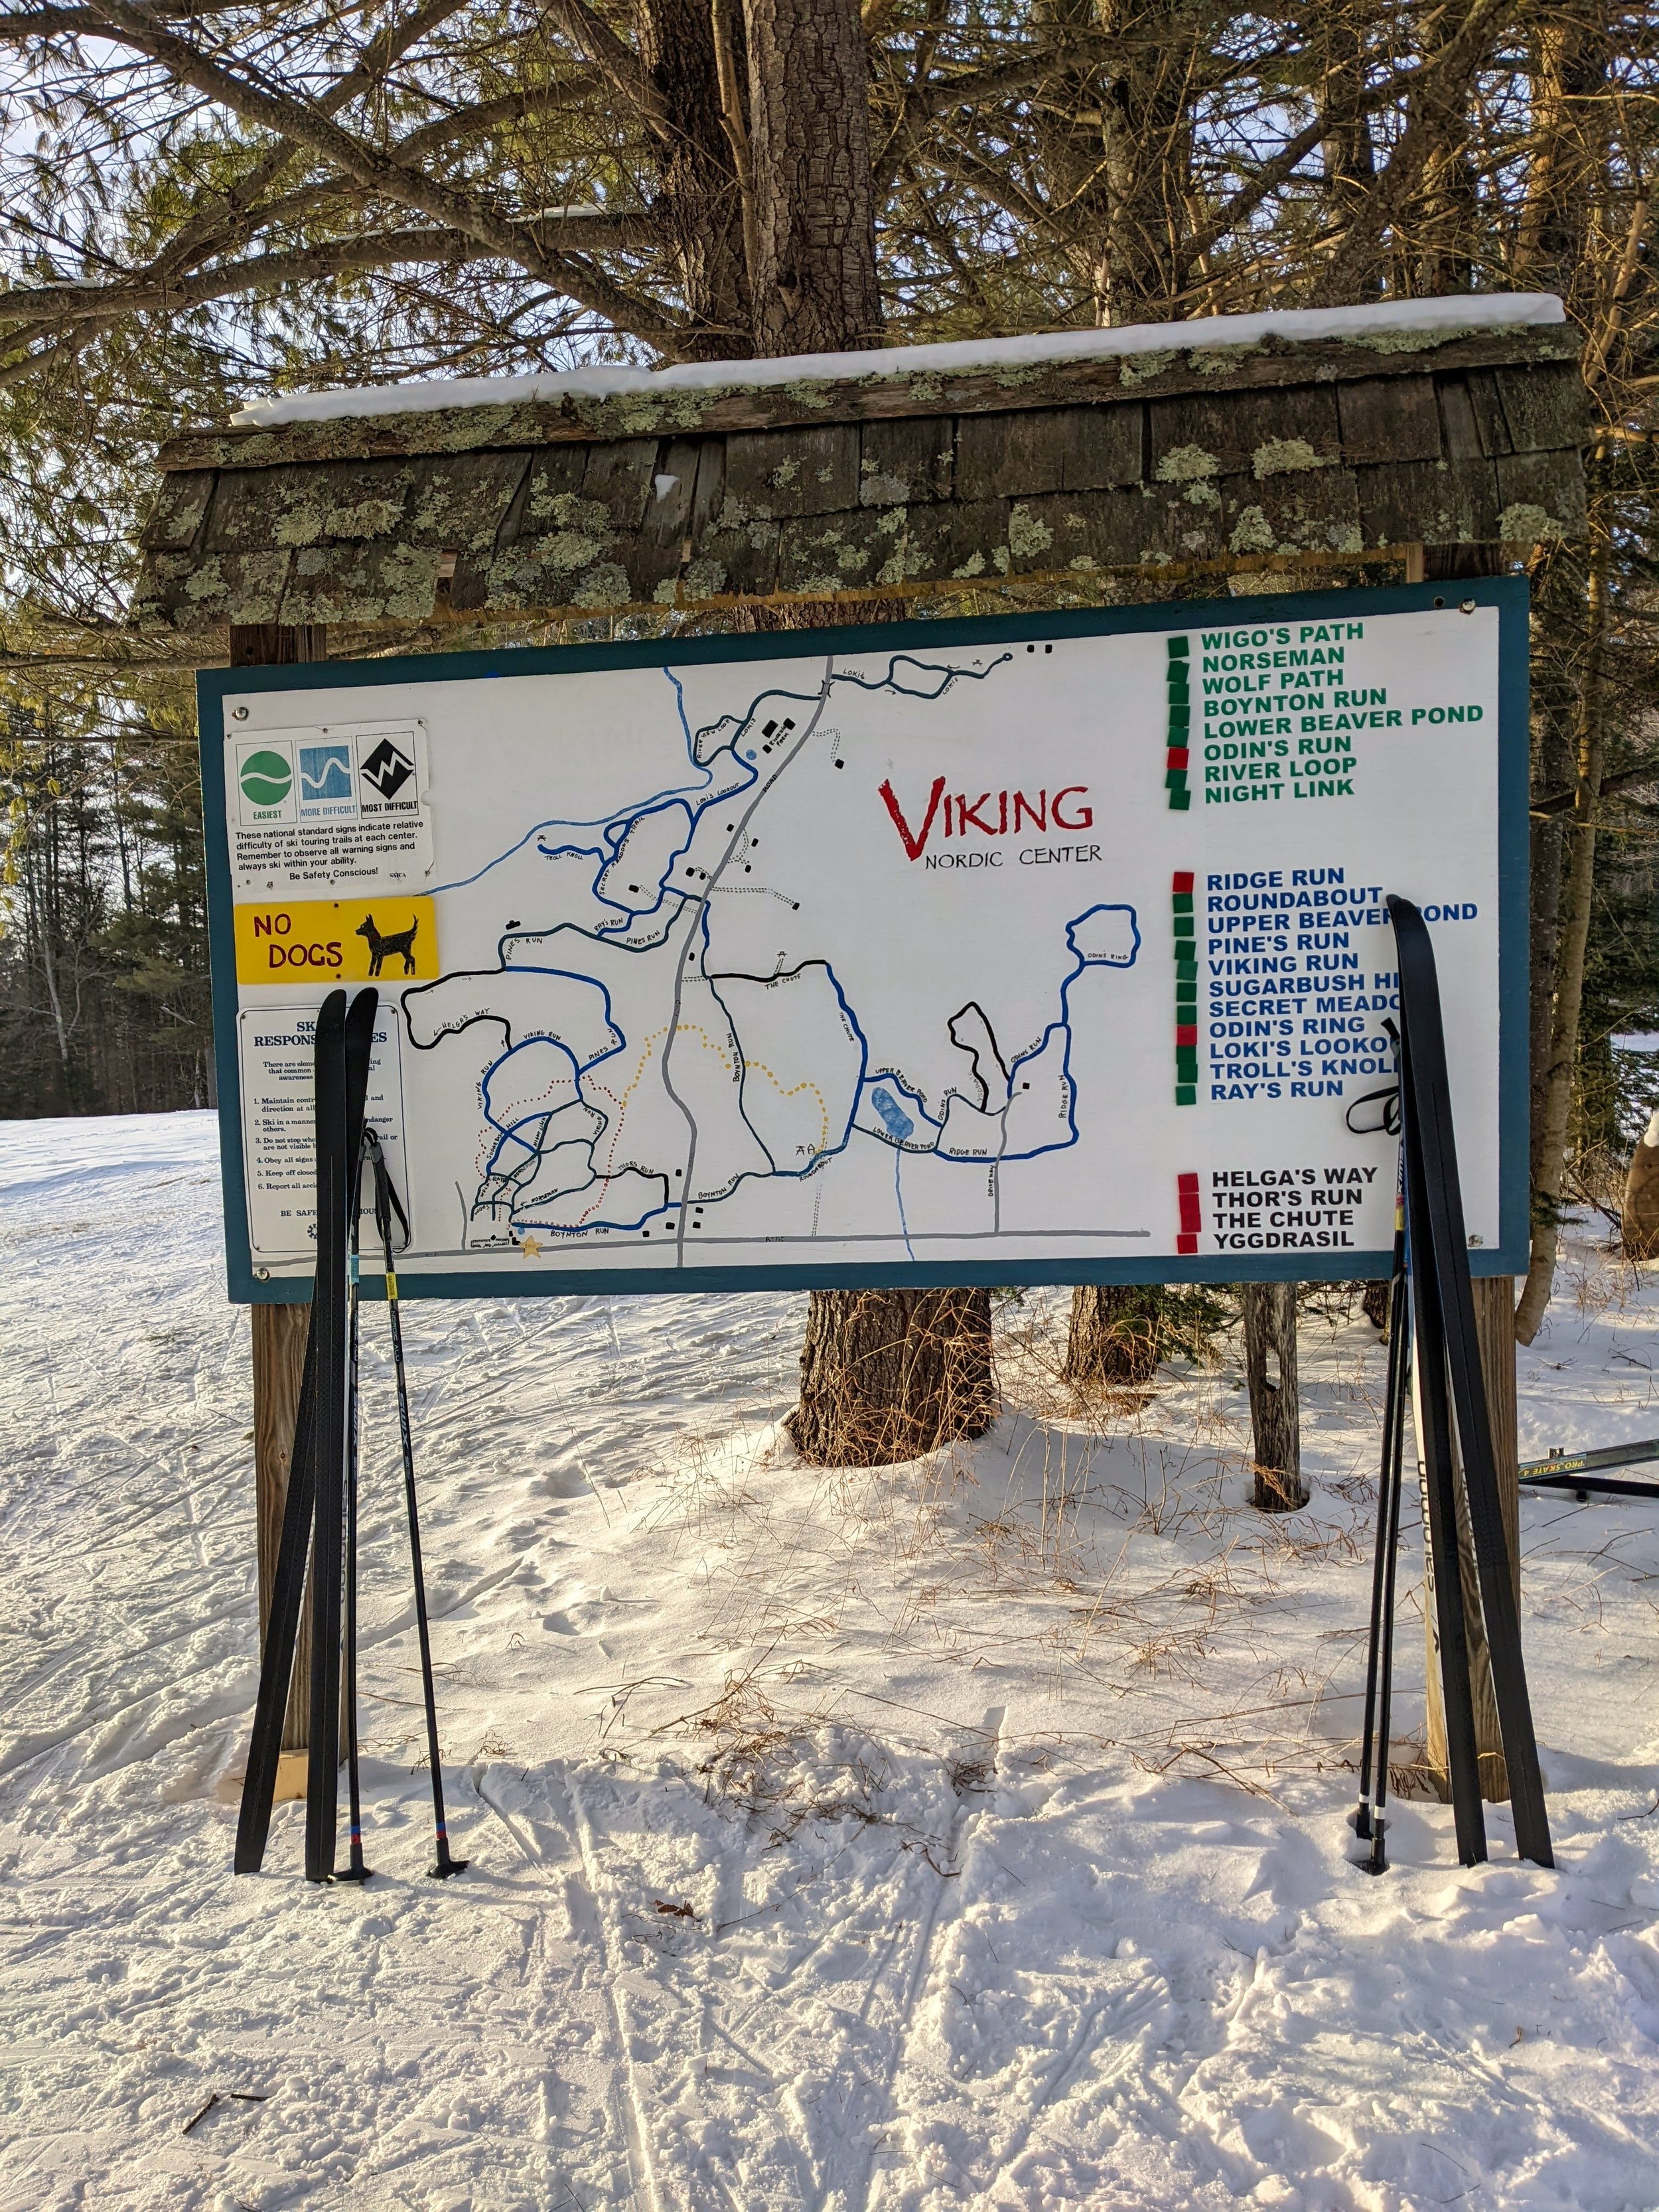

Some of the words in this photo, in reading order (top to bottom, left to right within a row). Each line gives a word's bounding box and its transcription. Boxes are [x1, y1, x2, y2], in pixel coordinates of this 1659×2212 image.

[1201, 627, 1291, 650] WIGO'S
[1301, 623, 1364, 643] PATH
[1202, 647, 1344, 672] NORSEMAN
[1202, 674, 1271, 694] WOLF
[1281, 669, 1343, 689] PATH
[1204, 693, 1324, 717] BOYNTON
[1334, 688, 1387, 707] RUN
[1204, 717, 1291, 739] LOWER
[1301, 709, 1403, 733] BEAVER
[1412, 705, 1483, 725] POND
[1204, 739, 1289, 761] ODIN'S
[1299, 736, 1351, 754] RUN
[1205, 762, 1281, 782] RIVER
[1291, 757, 1357, 777] LOOP
[1206, 783, 1285, 803] NIGHT
[1294, 779, 1354, 798] LINK
[253, 810, 282, 820] EASIEST
[301, 808, 321, 817] MORE
[323, 805, 356, 815] DIFFICULT
[362, 802, 382, 813] MOST
[384, 800, 417, 811] DIFFICULT
[630, 816, 646, 834] TRAIL
[878, 775, 1093, 861] VIKING
[235, 832, 261, 840] These
[263, 828, 295, 838] national
[298, 826, 333, 836] standard
[335, 825, 356, 835] signs
[358, 822, 391, 832] indicate
[393, 820, 424, 830] relative
[236, 841, 272, 851] difficulty
[301, 838, 330, 848] touring
[366, 833, 386, 842] each
[388, 832, 418, 840] center.
[236, 851, 281, 861] Remember
[294, 848, 327, 857] observe
[342, 845, 374, 855] warning
[376, 843, 397, 853] signs
[566, 851, 584, 860] KNOLL
[925, 851, 1003, 869] NORDIC
[1019, 845, 1102, 865] CENTER
[238, 861, 267, 871] always
[283, 859, 307, 867] within
[309, 857, 328, 867] your
[330, 855, 356, 865] ability.
[303, 869, 330, 881] Safety
[332, 867, 378, 877] Conscious!
[1207, 871, 1283, 891] RIDGE
[1292, 867, 1344, 887] RUN
[1208, 887, 1383, 912] ROUNDABOUT
[253, 913, 291, 937] NO
[610, 917, 624, 926] RUN
[1208, 913, 1290, 934] UPPER
[1415, 903, 1478, 921] OND
[626, 936, 646, 945] PINES
[647, 929, 661, 940] RUN
[1208, 935, 1288, 954] PINE'S
[1297, 932, 1350, 950] RUN
[269, 941, 343, 968] DOGS
[506, 938, 520, 960] PINES
[1208, 956, 1297, 976] VIKING
[1306, 953, 1358, 971] RUN
[764, 981, 779, 990] THE
[782, 973, 802, 984] CHUTE
[1209, 974, 1364, 997] SUGARBUSH
[474, 1007, 490, 1016] WAY
[1209, 997, 1307, 1017] SECRET
[523, 1029, 545, 1040] VIKING
[548, 1031, 561, 1041] RUN
[838, 1011, 847, 1023] THE
[843, 1024, 855, 1042] CHUTE
[1209, 1019, 1293, 1039] ODIN'S
[1303, 1016, 1365, 1035] RING
[588, 1046, 609, 1061] PINES
[1029, 1036, 1043, 1052] RUN
[1210, 1040, 1291, 1059] LOKI'S
[480, 1060, 494, 1075] RUN
[1210, 1060, 1313, 1080] TROLL'S
[897, 1069, 916, 1092] BEAVER
[1058, 1074, 1068, 1093] RUN
[1211, 1081, 1281, 1100] RAY'S
[1291, 1080, 1343, 1097] RUN
[944, 1087, 957, 1097] RUN
[1058, 1094, 1068, 1118] RIDGE
[873, 1126, 893, 1143] LOWER
[920, 1142, 935, 1150] POND
[949, 1147, 970, 1156] RIDGE
[640, 1165, 654, 1174] RUN
[798, 1157, 833, 1182] ROUNDABOUT
[1212, 1169, 1315, 1187] HELGA'S
[1323, 1167, 1378, 1185] WAY
[698, 1187, 727, 1199] BOYNTON
[728, 1173, 740, 1186] RUN
[1212, 1190, 1302, 1208] THOR'S
[1311, 1189, 1362, 1205] RUN
[1213, 1212, 1261, 1228] THE
[1269, 1209, 1354, 1228] CHUTE
[550, 1230, 589, 1239] BOYNTON
[1213, 1230, 1354, 1249] YGGDRASIL
[1532, 1463, 1561, 1475] SKATE
[1565, 1459, 1585, 1469] PRO
